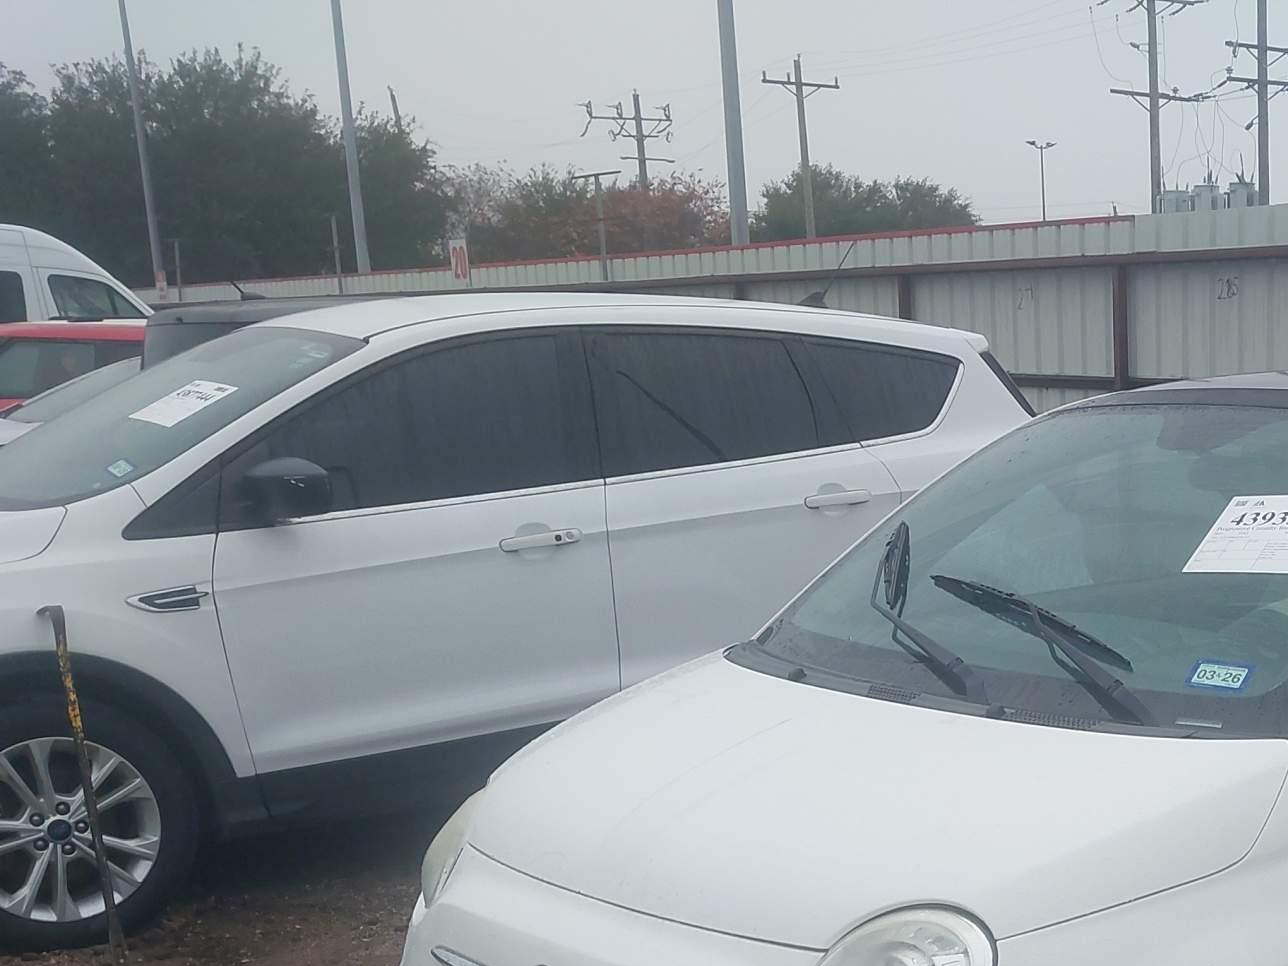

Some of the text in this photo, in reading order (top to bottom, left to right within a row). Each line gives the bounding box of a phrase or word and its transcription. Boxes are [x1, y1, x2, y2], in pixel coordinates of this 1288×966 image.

[452, 245, 467, 280] 20
[1196, 669, 1242, 684] 03 26
